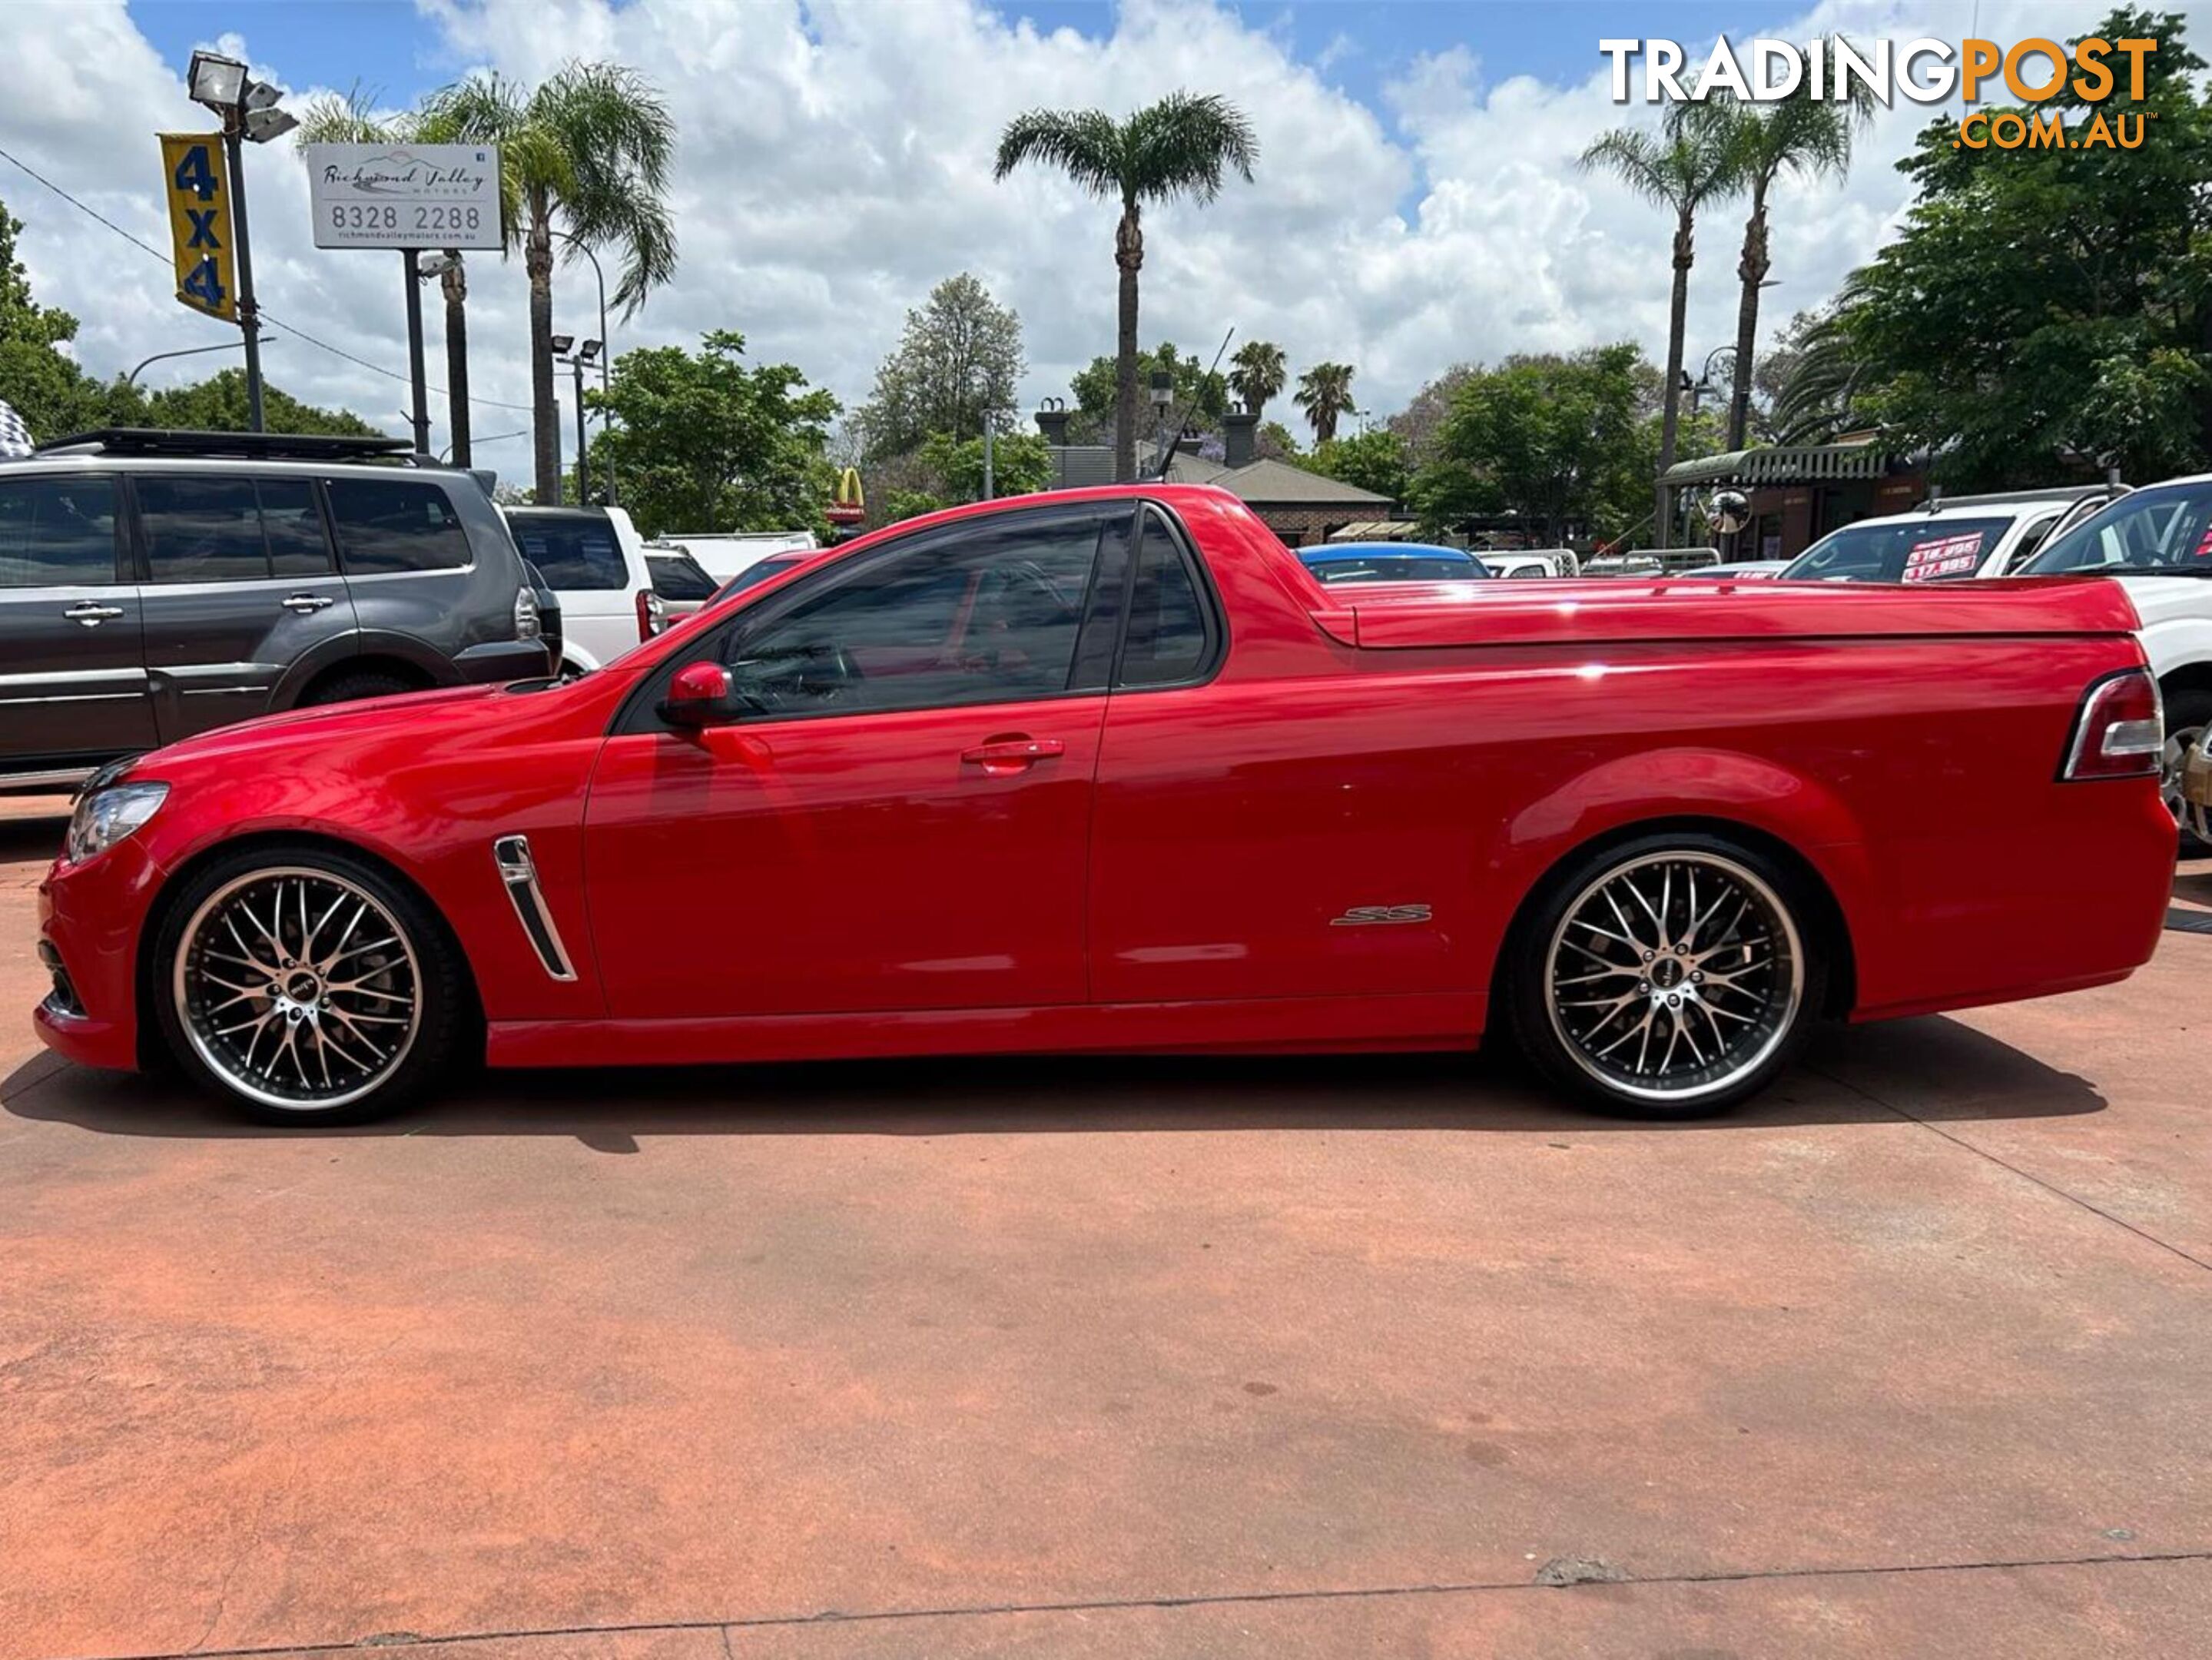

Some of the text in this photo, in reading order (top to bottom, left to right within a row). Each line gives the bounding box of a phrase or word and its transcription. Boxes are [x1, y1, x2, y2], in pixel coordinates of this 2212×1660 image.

[324, 164, 486, 191] Richmond Valley
[332, 206, 479, 230] 8328 2288
[338, 231, 476, 241] richmondvalleymotors.com.au
[1329, 904, 1432, 926] SS
